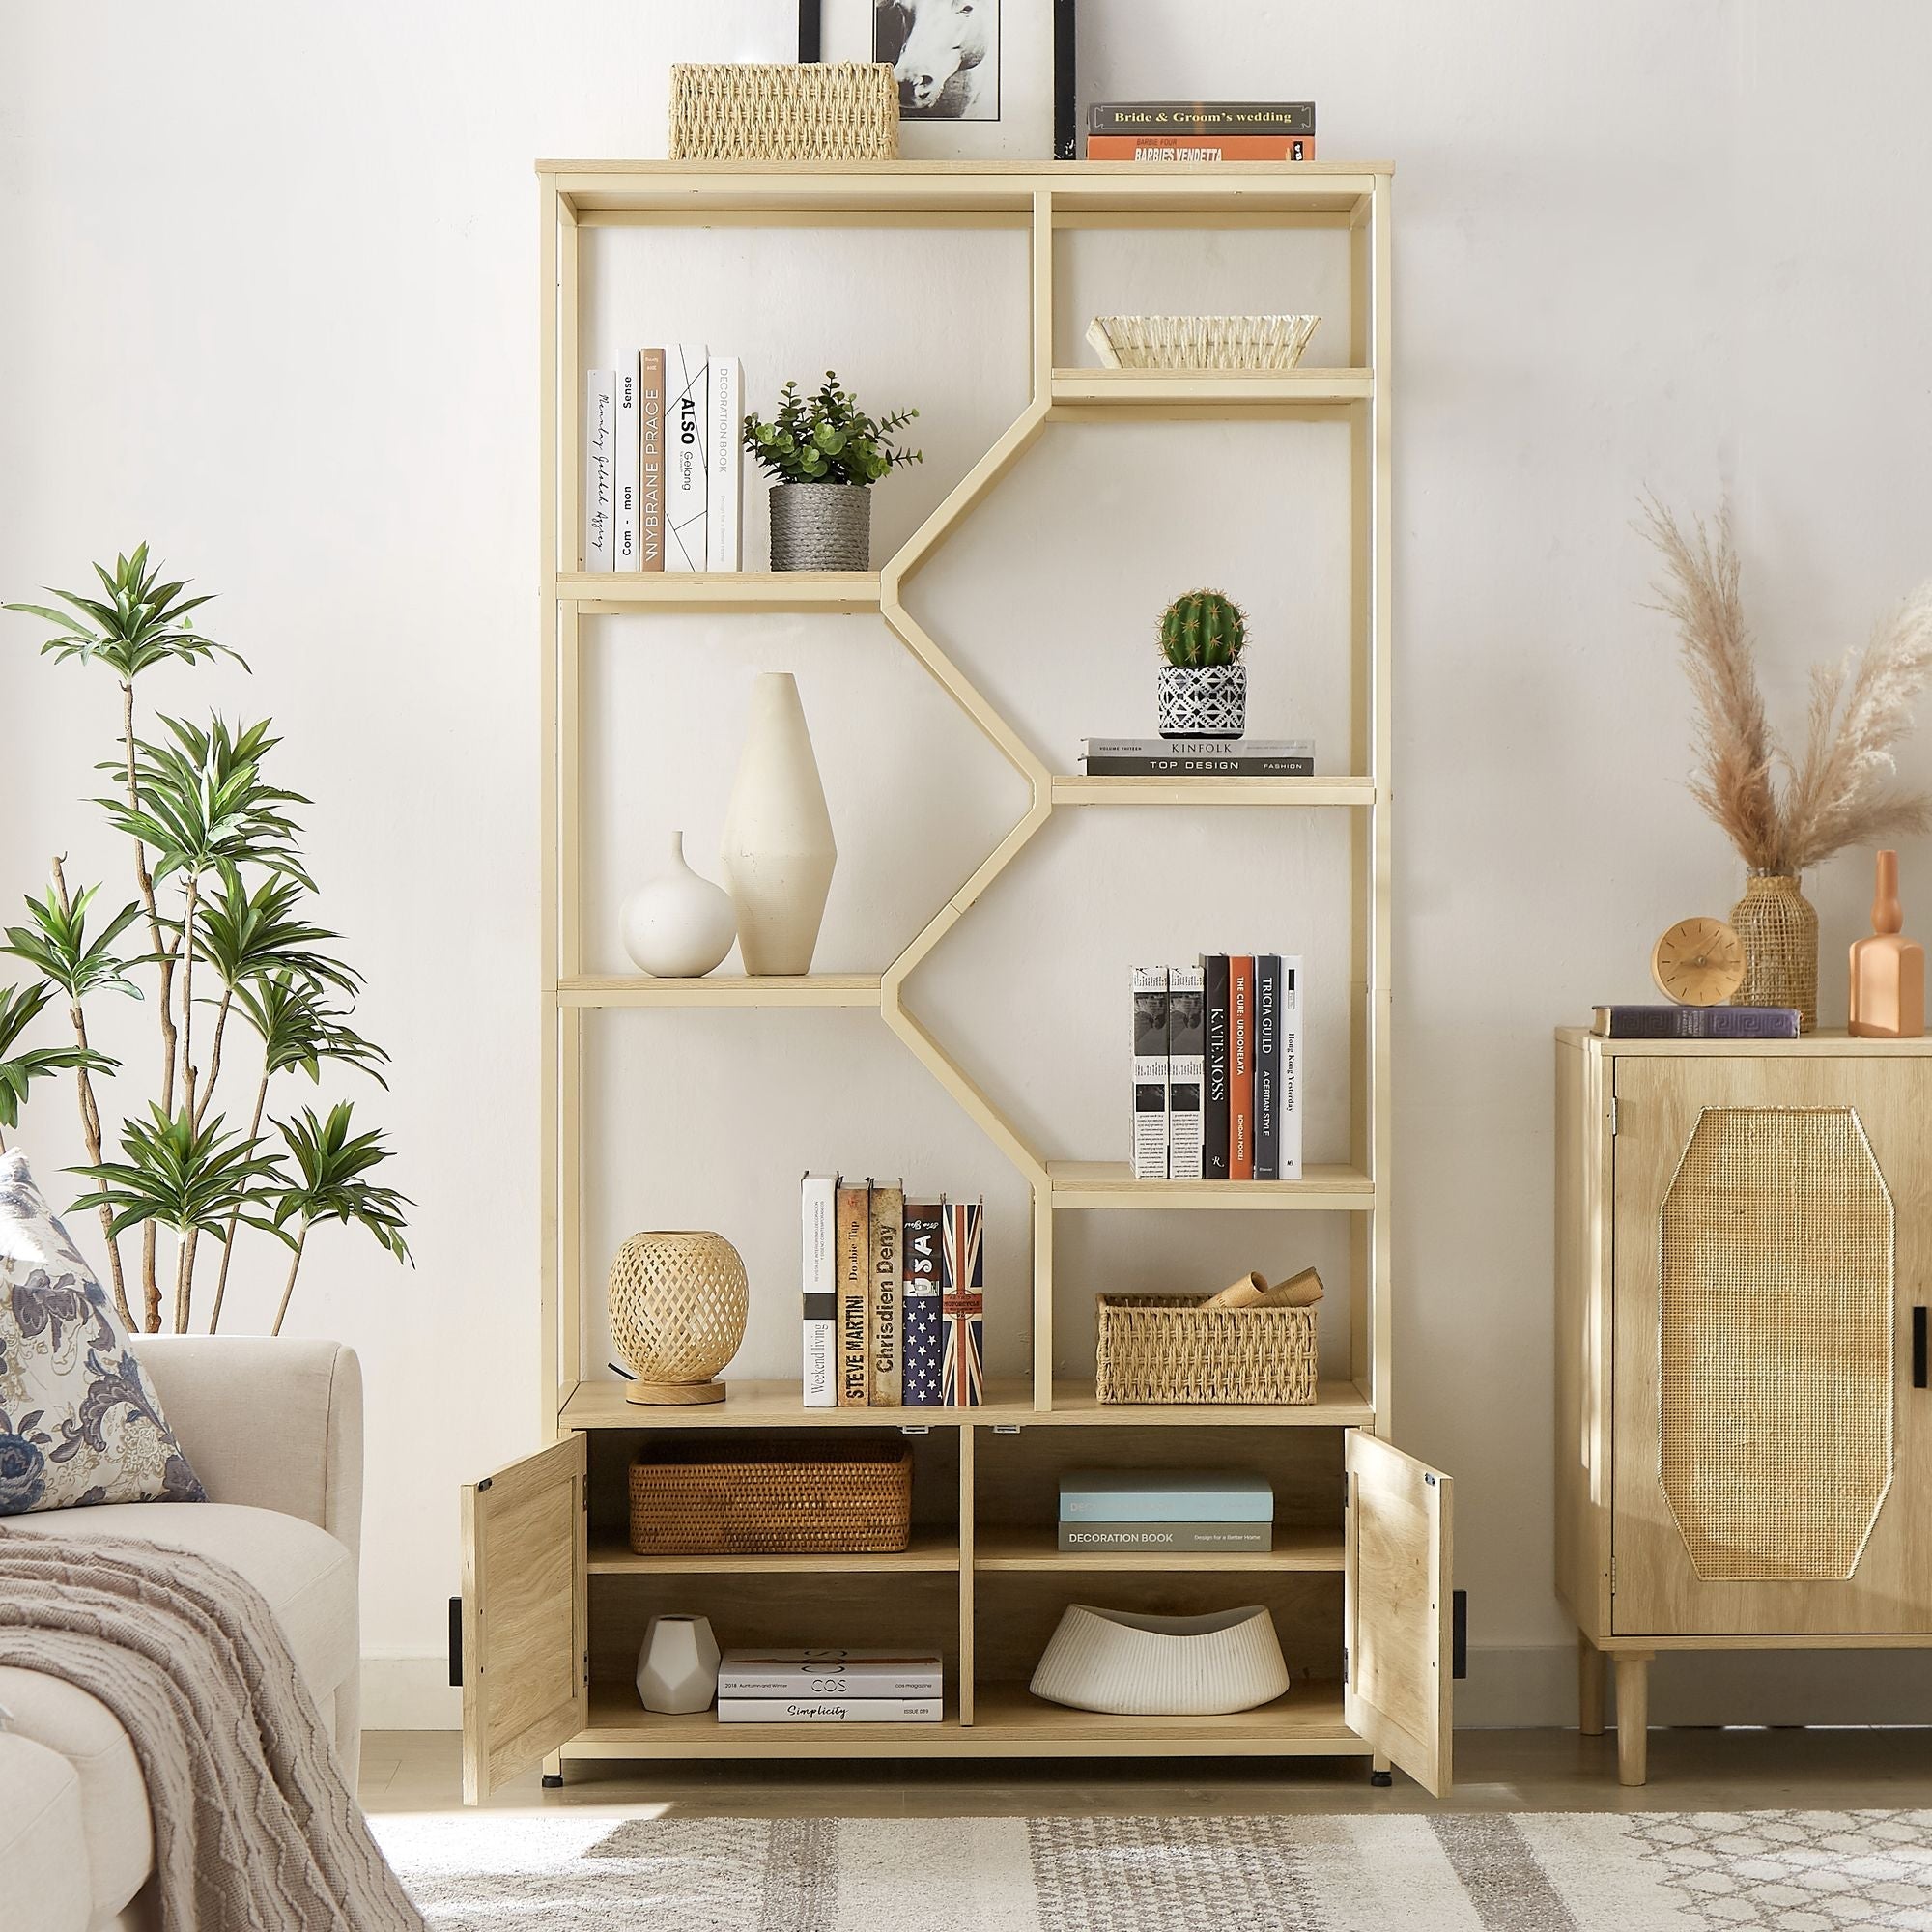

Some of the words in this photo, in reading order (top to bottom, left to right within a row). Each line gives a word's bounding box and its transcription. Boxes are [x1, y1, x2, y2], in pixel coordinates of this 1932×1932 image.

[1114, 111, 1152, 122] Bride
[1155, 111, 1169, 122] &
[1172, 111, 1233, 122] Groom's
[1236, 111, 1292, 124] wedding
[1176, 148, 1223, 161] VENDETTA
[622, 376, 632, 409] Sense
[719, 368, 728, 440] DECORATION
[645, 388, 659, 456] PRACE
[680, 397, 696, 445] ALSO
[681, 450, 694, 492] Gelang
[719, 441, 728, 473] BOOK
[645, 462, 659, 562] WYBRANE
[622, 530, 632, 556] Com
[1150, 761, 1179, 770] TOP
[1184, 761, 1239, 770] DESIGN
[1171, 743, 1233, 753] KINFOLK
[1262, 978, 1273, 1016] TRICIA
[1211, 1008, 1224, 1053] KATE
[1262, 1017, 1272, 1055] GUILD
[1287, 1033, 1295, 1053] Hong
[1211, 1053, 1224, 1101] MOSS
[1287, 1054, 1295, 1075] Kong
[1287, 1076, 1295, 1113] Yesterday
[875, 1224, 897, 1274] Deny
[810, 1323, 829, 1349] living
[845, 1295, 865, 1350] MARTINI
[875, 1280, 894, 1374] Chrisdien
[810, 1350, 825, 1394] Weekend
[845, 1354, 865, 1399] STEVE
[1068, 1533, 1139, 1543] DECORATION
[1141, 1533, 1174, 1543] BOOK
[810, 1679, 847, 1692] COS
[786, 1704, 849, 1719] Simplicity
